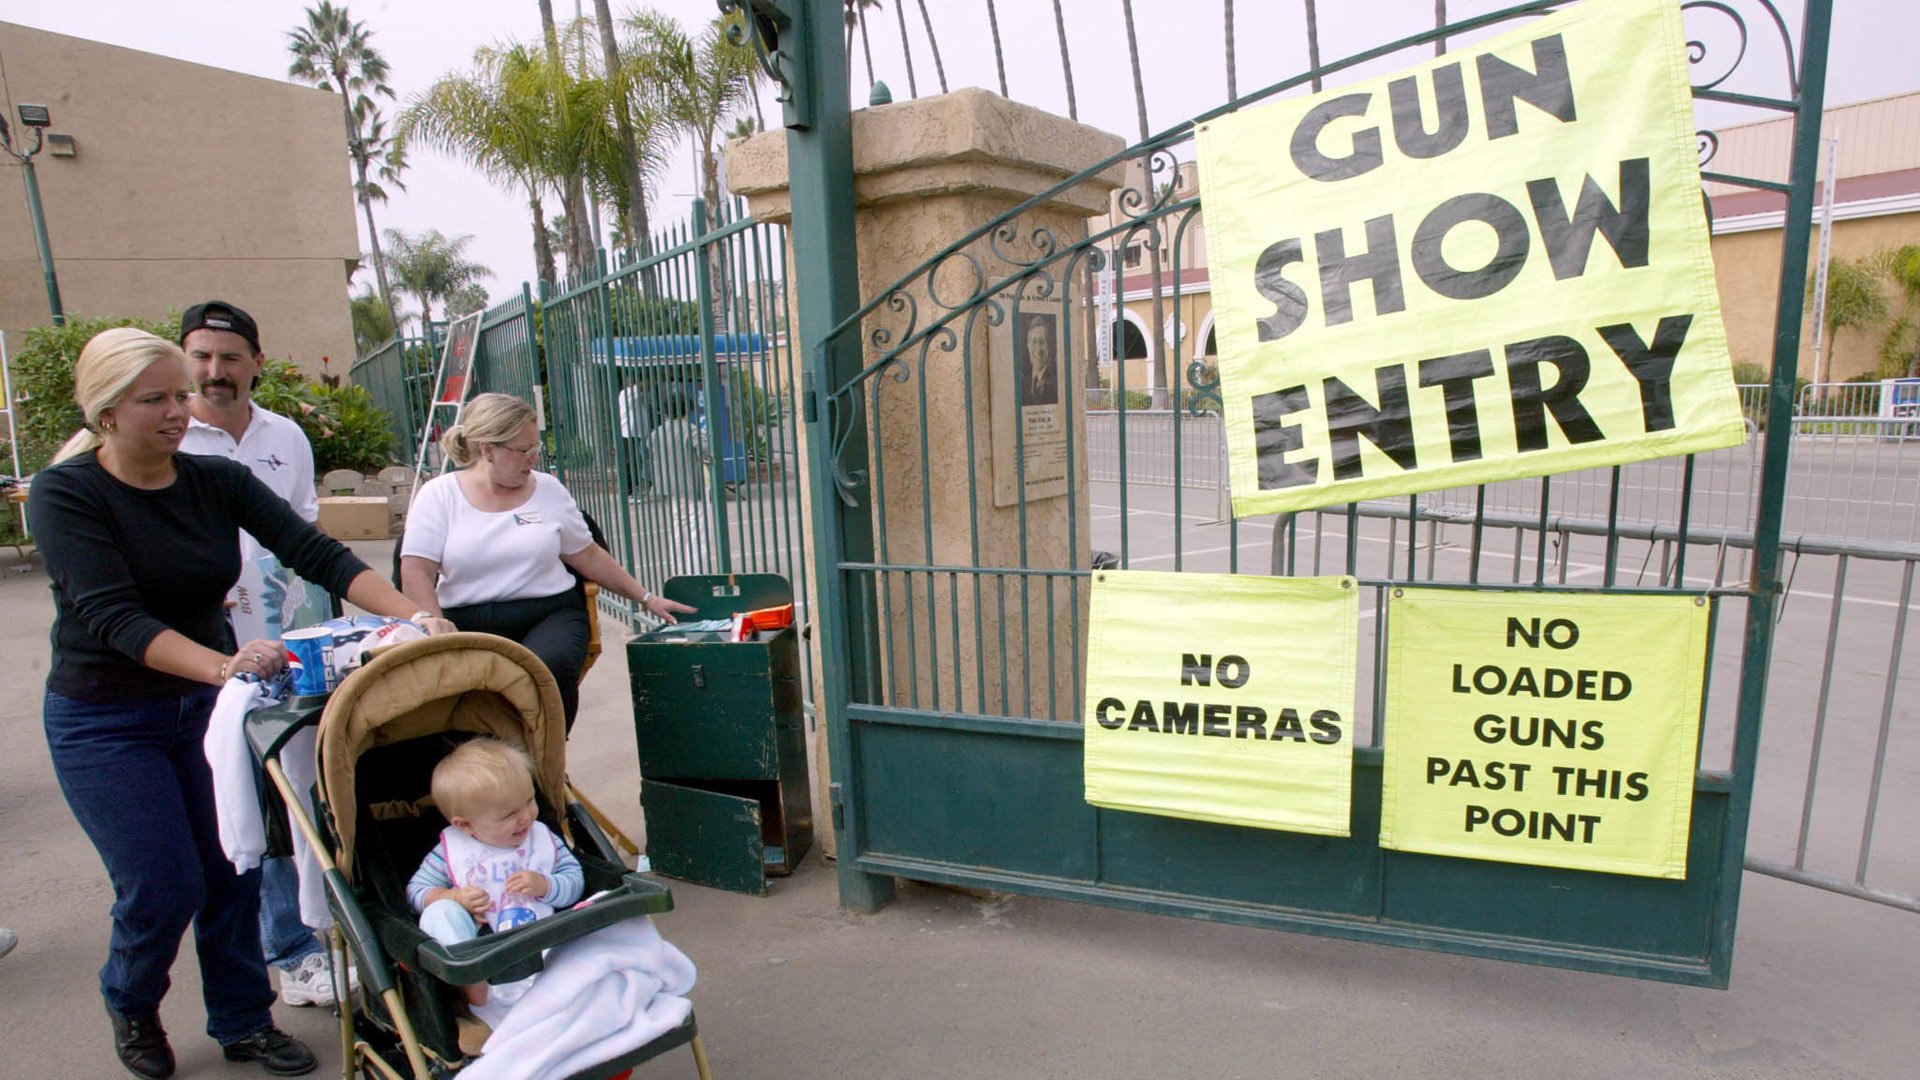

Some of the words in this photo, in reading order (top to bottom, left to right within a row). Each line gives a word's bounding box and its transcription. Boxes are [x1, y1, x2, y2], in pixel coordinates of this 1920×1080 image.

[1290, 34, 1577, 182] GUN
[1255, 158, 1650, 342] SHOW
[1251, 314, 1694, 490] ENTRY
[1507, 617, 1580, 649] NO
[321, 647, 336, 692] EPSI
[1181, 654, 1250, 689] NO
[1452, 664, 1632, 701] LOADED
[1096, 698, 1342, 745] CAMERAS
[1474, 714, 1605, 750] GUNS
[1427, 757, 1531, 791] PAST
[1553, 767, 1649, 801] THIS
[1465, 805, 1601, 843] POINT
